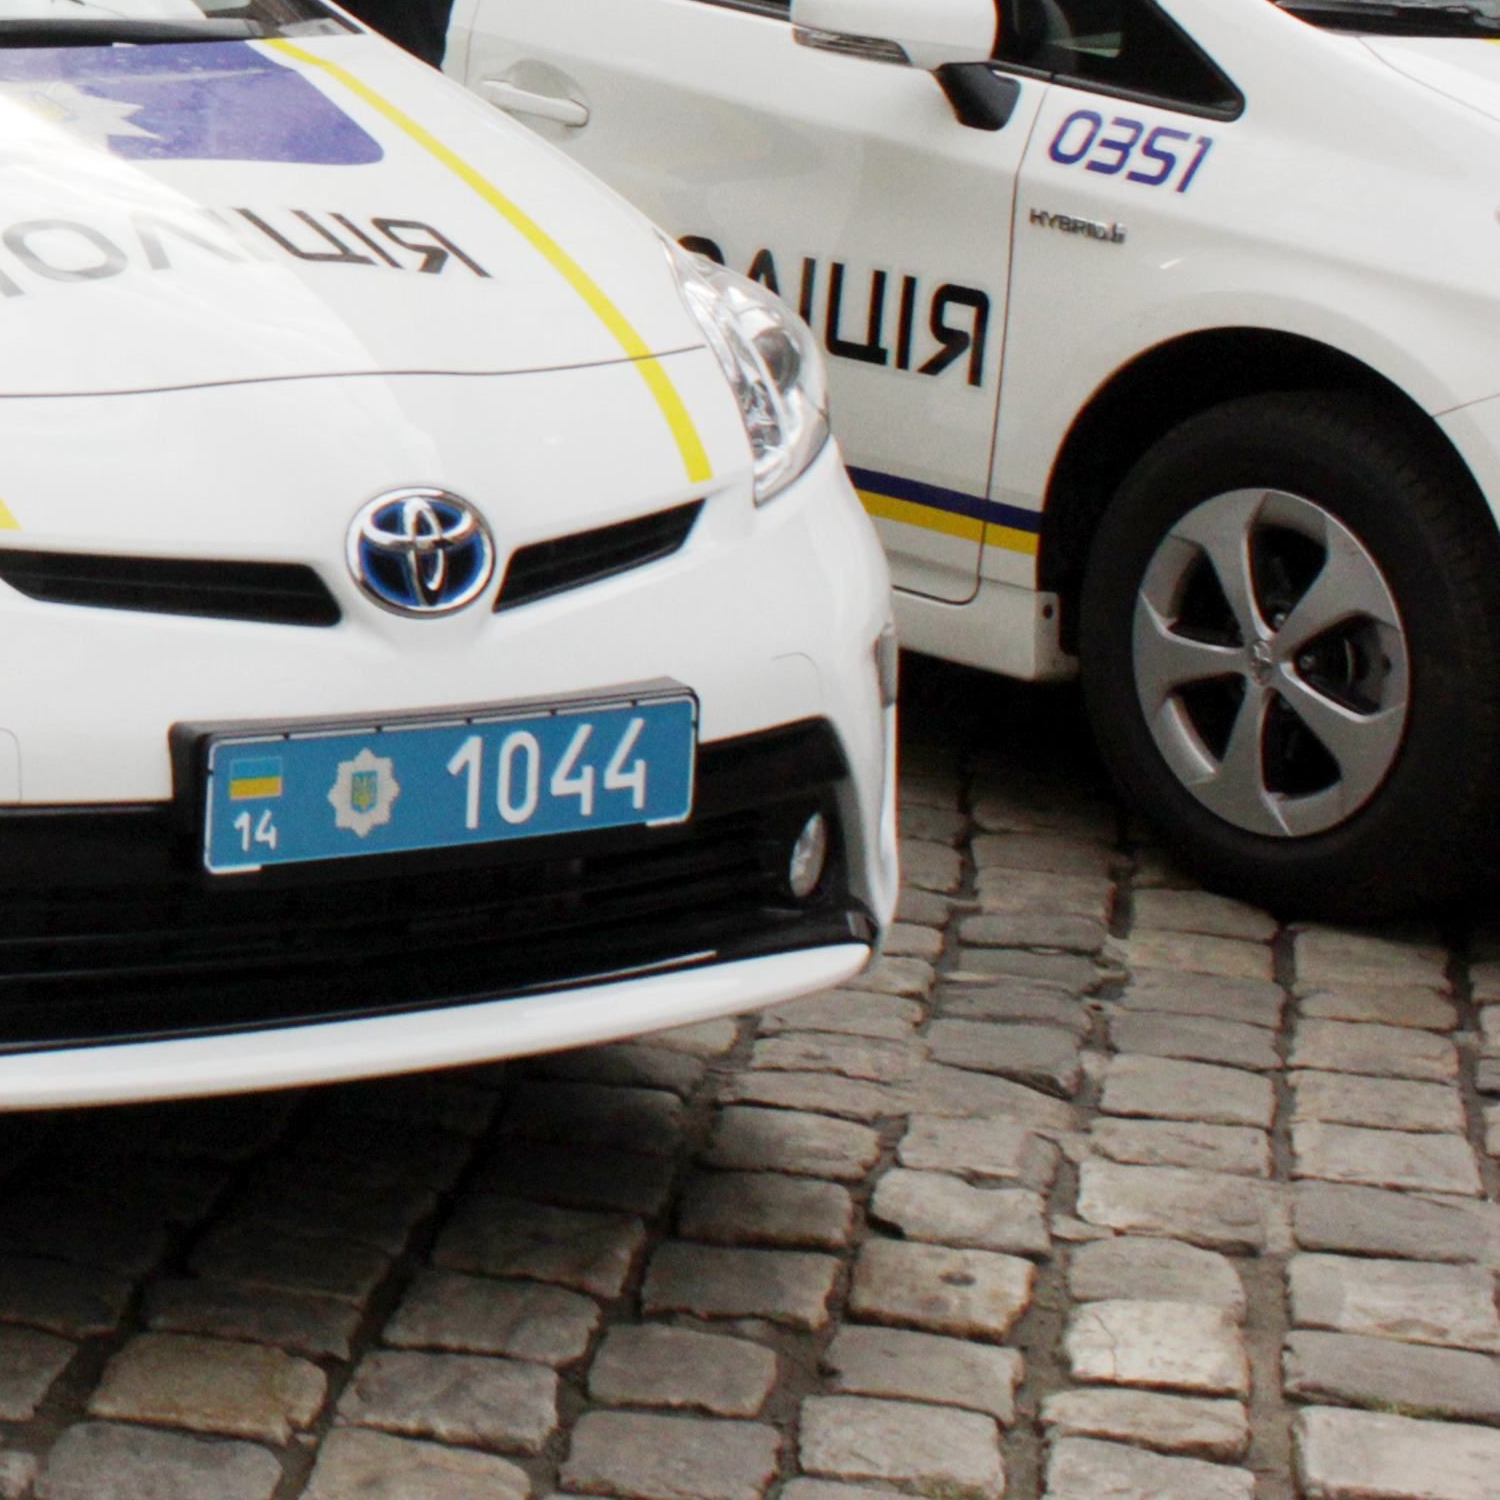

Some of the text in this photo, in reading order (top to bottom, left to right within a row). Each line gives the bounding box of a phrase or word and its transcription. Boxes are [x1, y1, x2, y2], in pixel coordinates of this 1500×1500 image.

[1048, 109, 1214, 194] 0351
[678, 235, 991, 388] ІЦІЯ
[446, 717, 648, 830] 1044
[232, 808, 279, 853] 14
